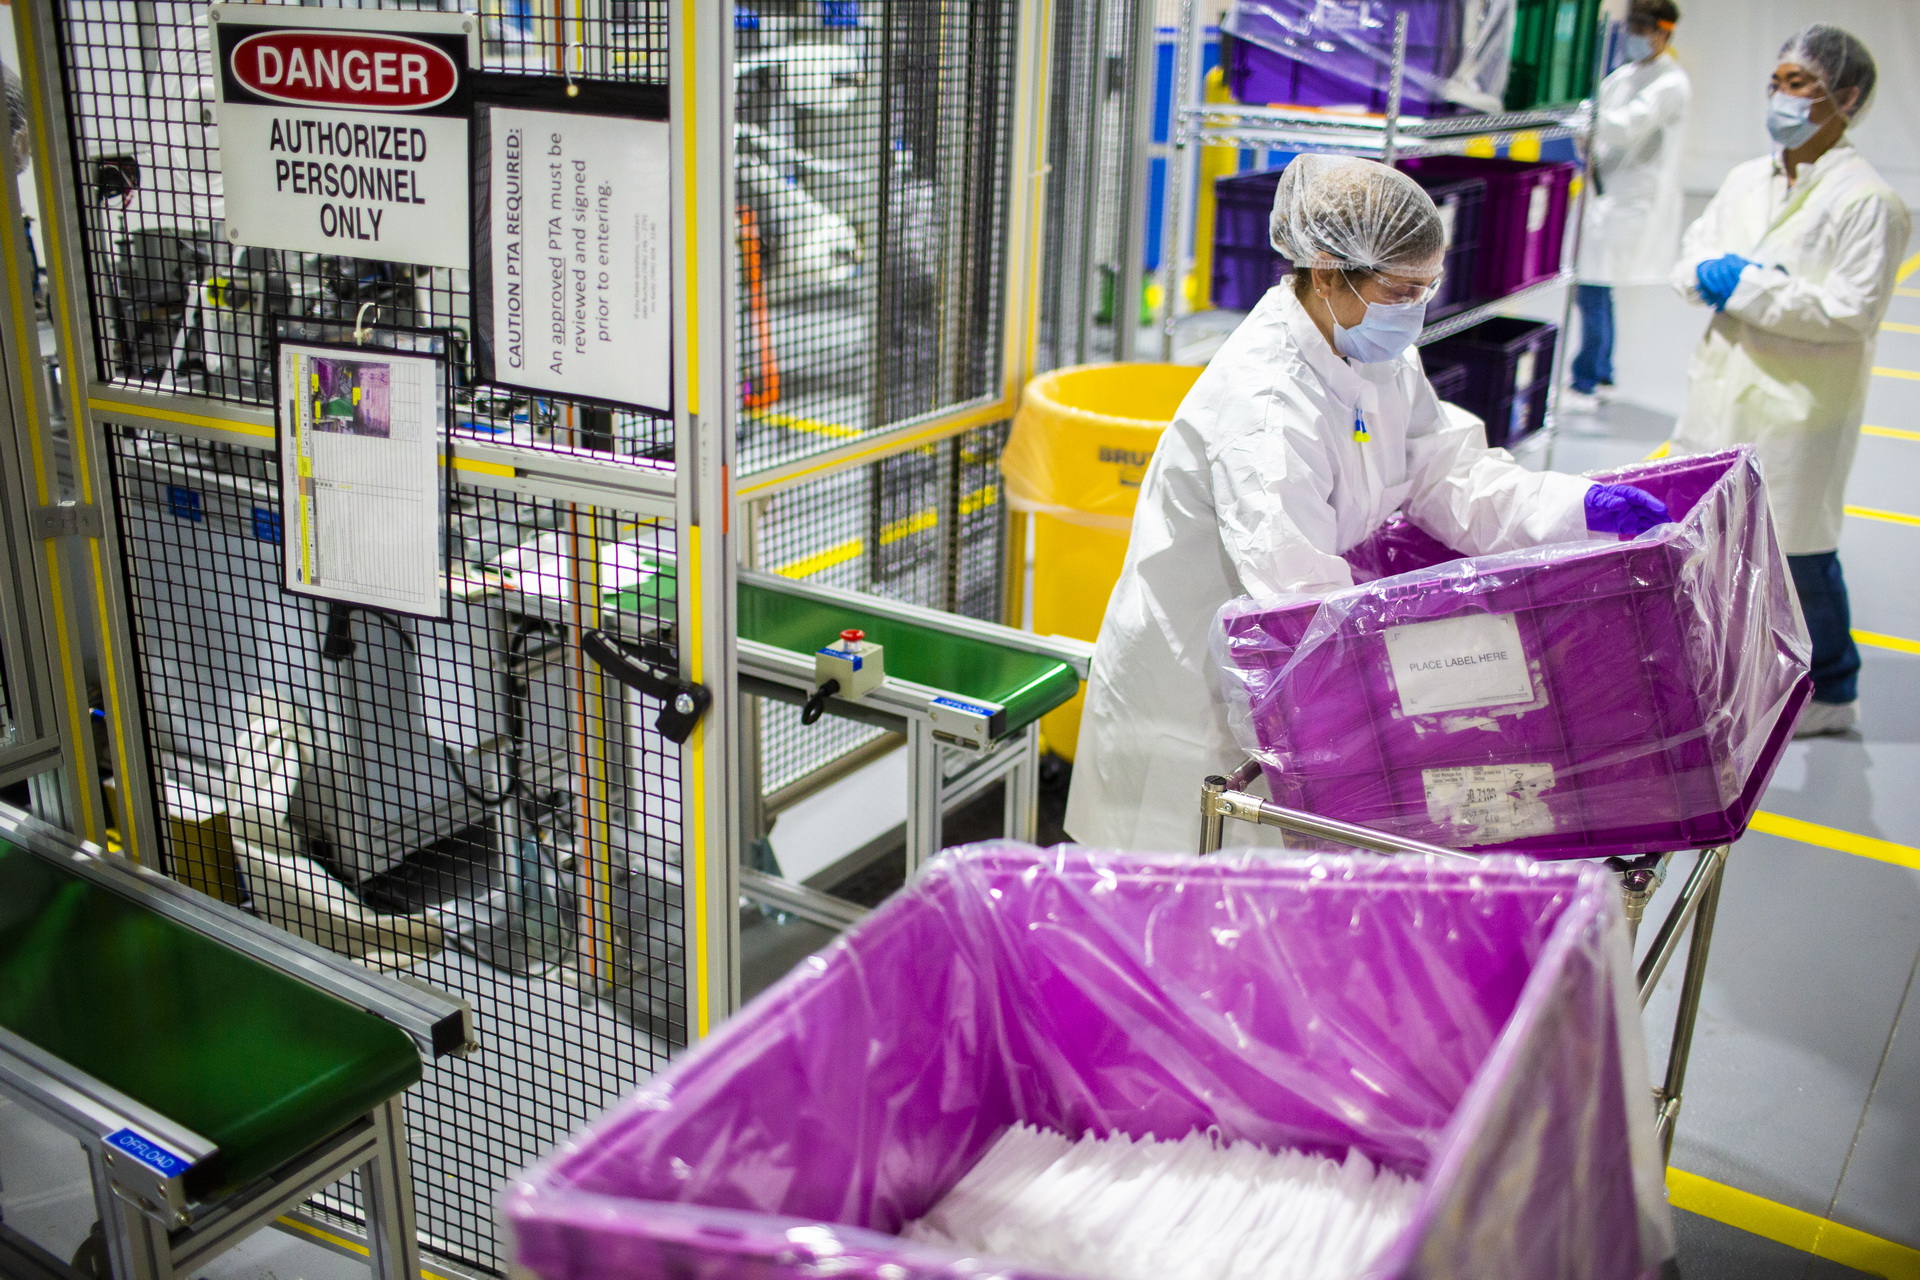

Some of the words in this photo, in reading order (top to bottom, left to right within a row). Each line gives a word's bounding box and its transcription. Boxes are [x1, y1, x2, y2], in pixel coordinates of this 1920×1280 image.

[257, 45, 429, 95] DANGER
[270, 118, 427, 162] AUTHORIZED
[547, 132, 562, 156] be
[275, 159, 426, 205] PERSONNEL
[506, 128, 522, 235] REQUIRED:
[549, 163, 562, 210] must
[571, 160, 589, 222] signed
[320, 203, 383, 241] ONLY
[548, 216, 562, 250] PTA
[595, 180, 612, 266] entering.
[507, 242, 520, 276] PTA
[571, 228, 586, 263] and
[548, 256, 565, 345] approved
[596, 271, 610, 290] to
[508, 282, 521, 369] CAUTION
[572, 269, 586, 354] reviewed
[595, 298, 612, 342] prior
[549, 350, 562, 375] An
[1409, 659, 1443, 672] PLACE
[1444, 656, 1477, 668] LABEL
[1478, 651, 1508, 663] HERE
[941, 700, 984, 714] OFFLOAD
[119, 1136, 175, 1168] OFFLOAD
